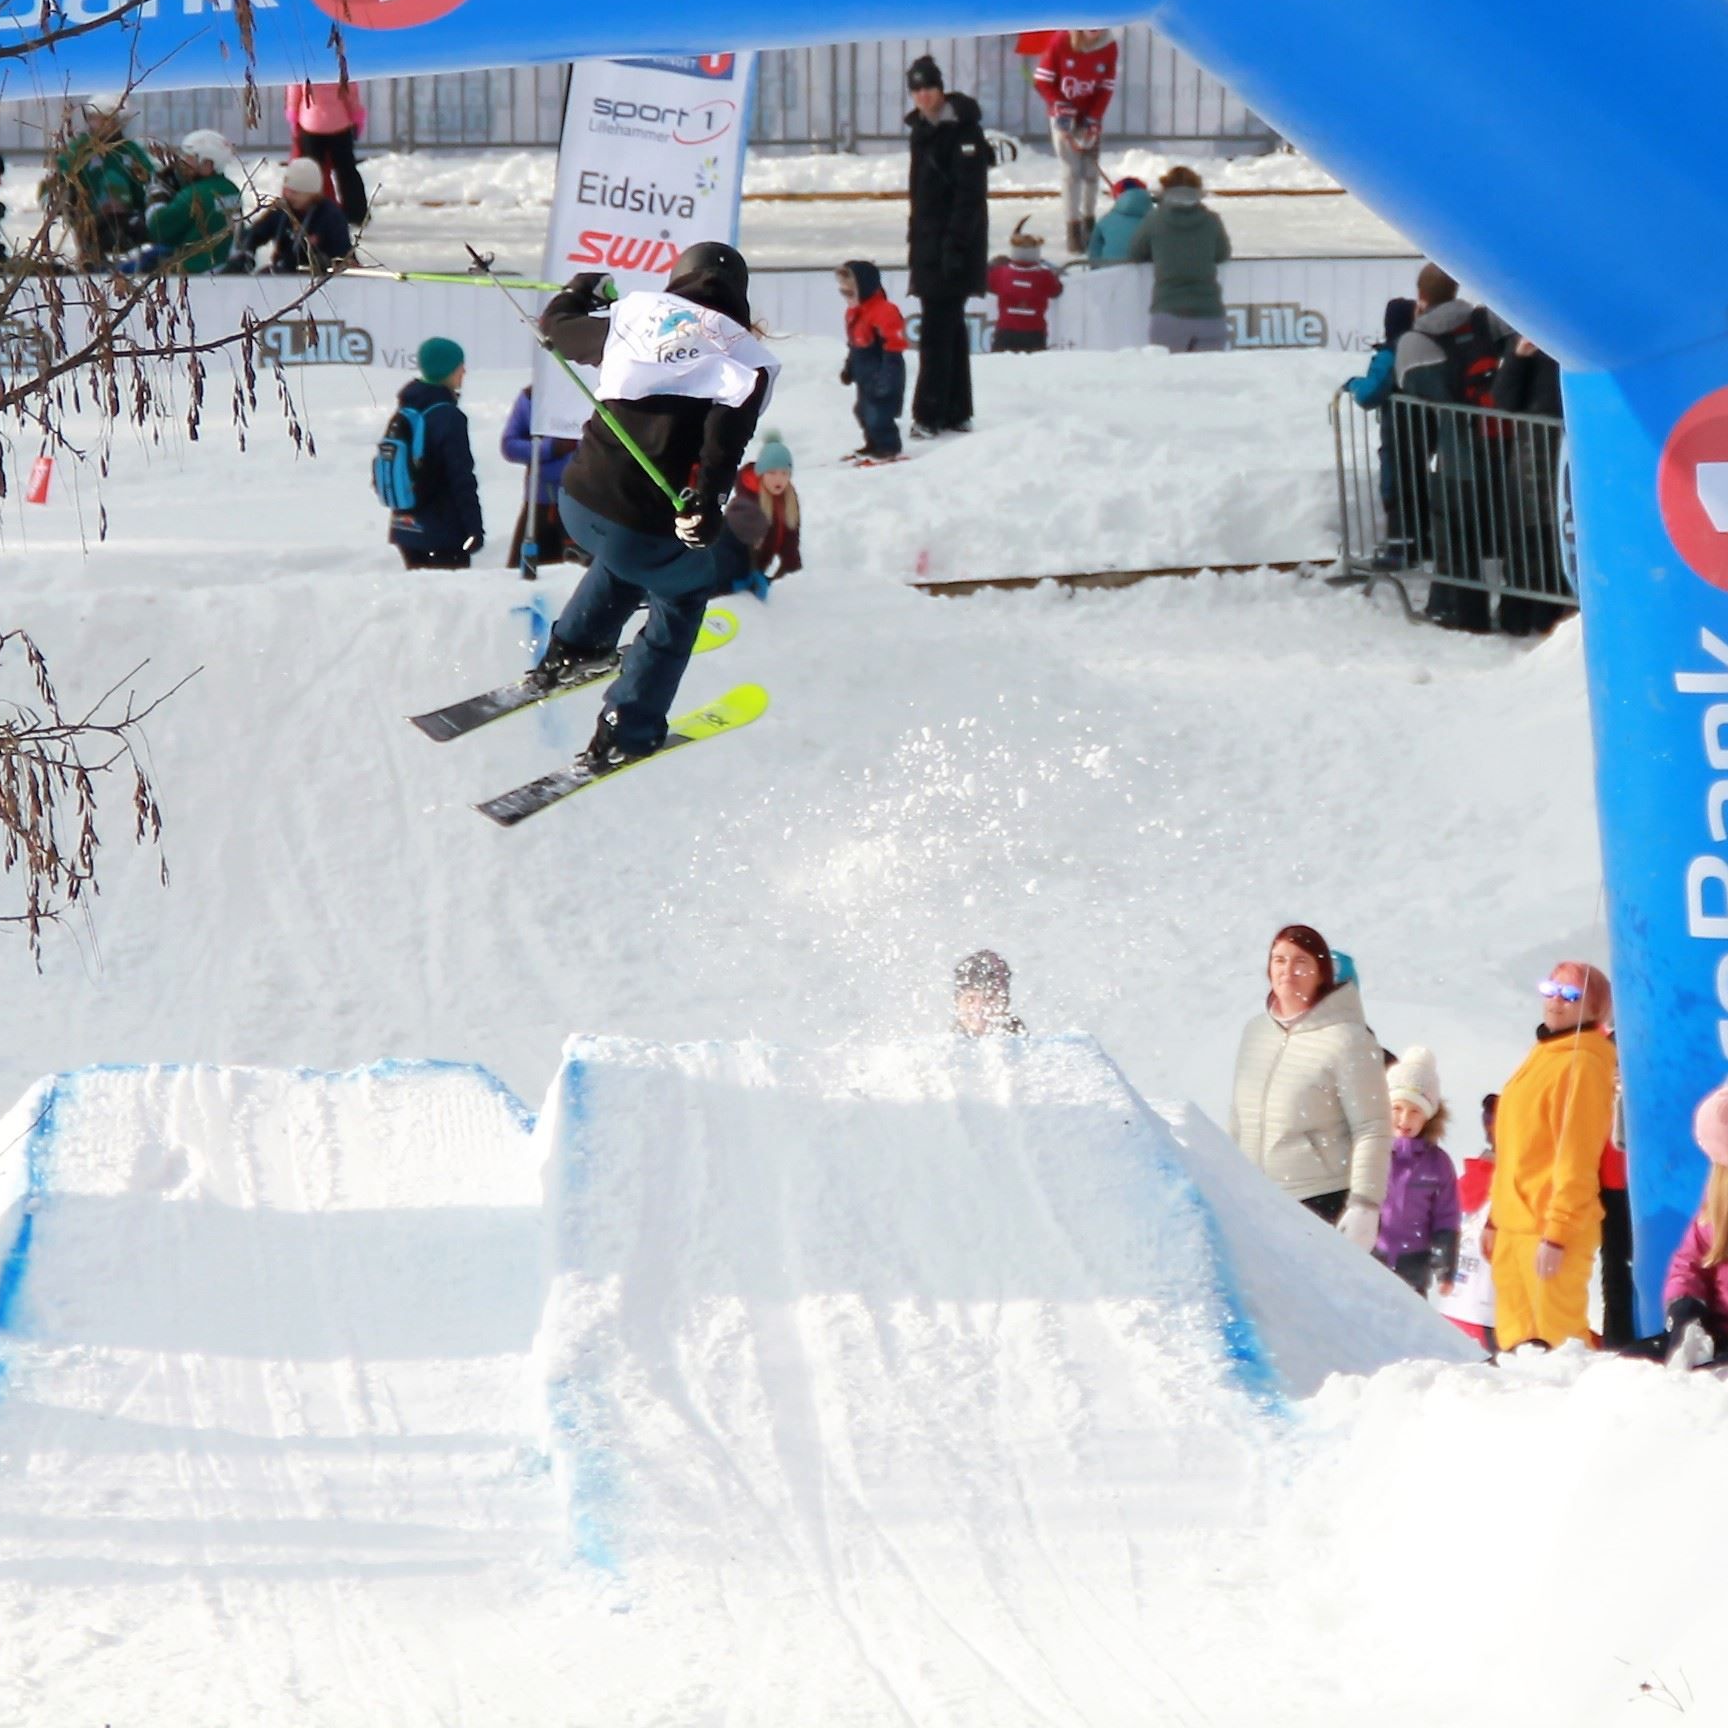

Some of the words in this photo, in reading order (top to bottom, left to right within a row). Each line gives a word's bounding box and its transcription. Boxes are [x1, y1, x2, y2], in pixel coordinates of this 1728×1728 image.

[592, 97, 689, 128] sport
[704, 111, 715, 130] 1
[588, 118, 671, 143] Lillehammer
[576, 170, 695, 219] Eidsiva
